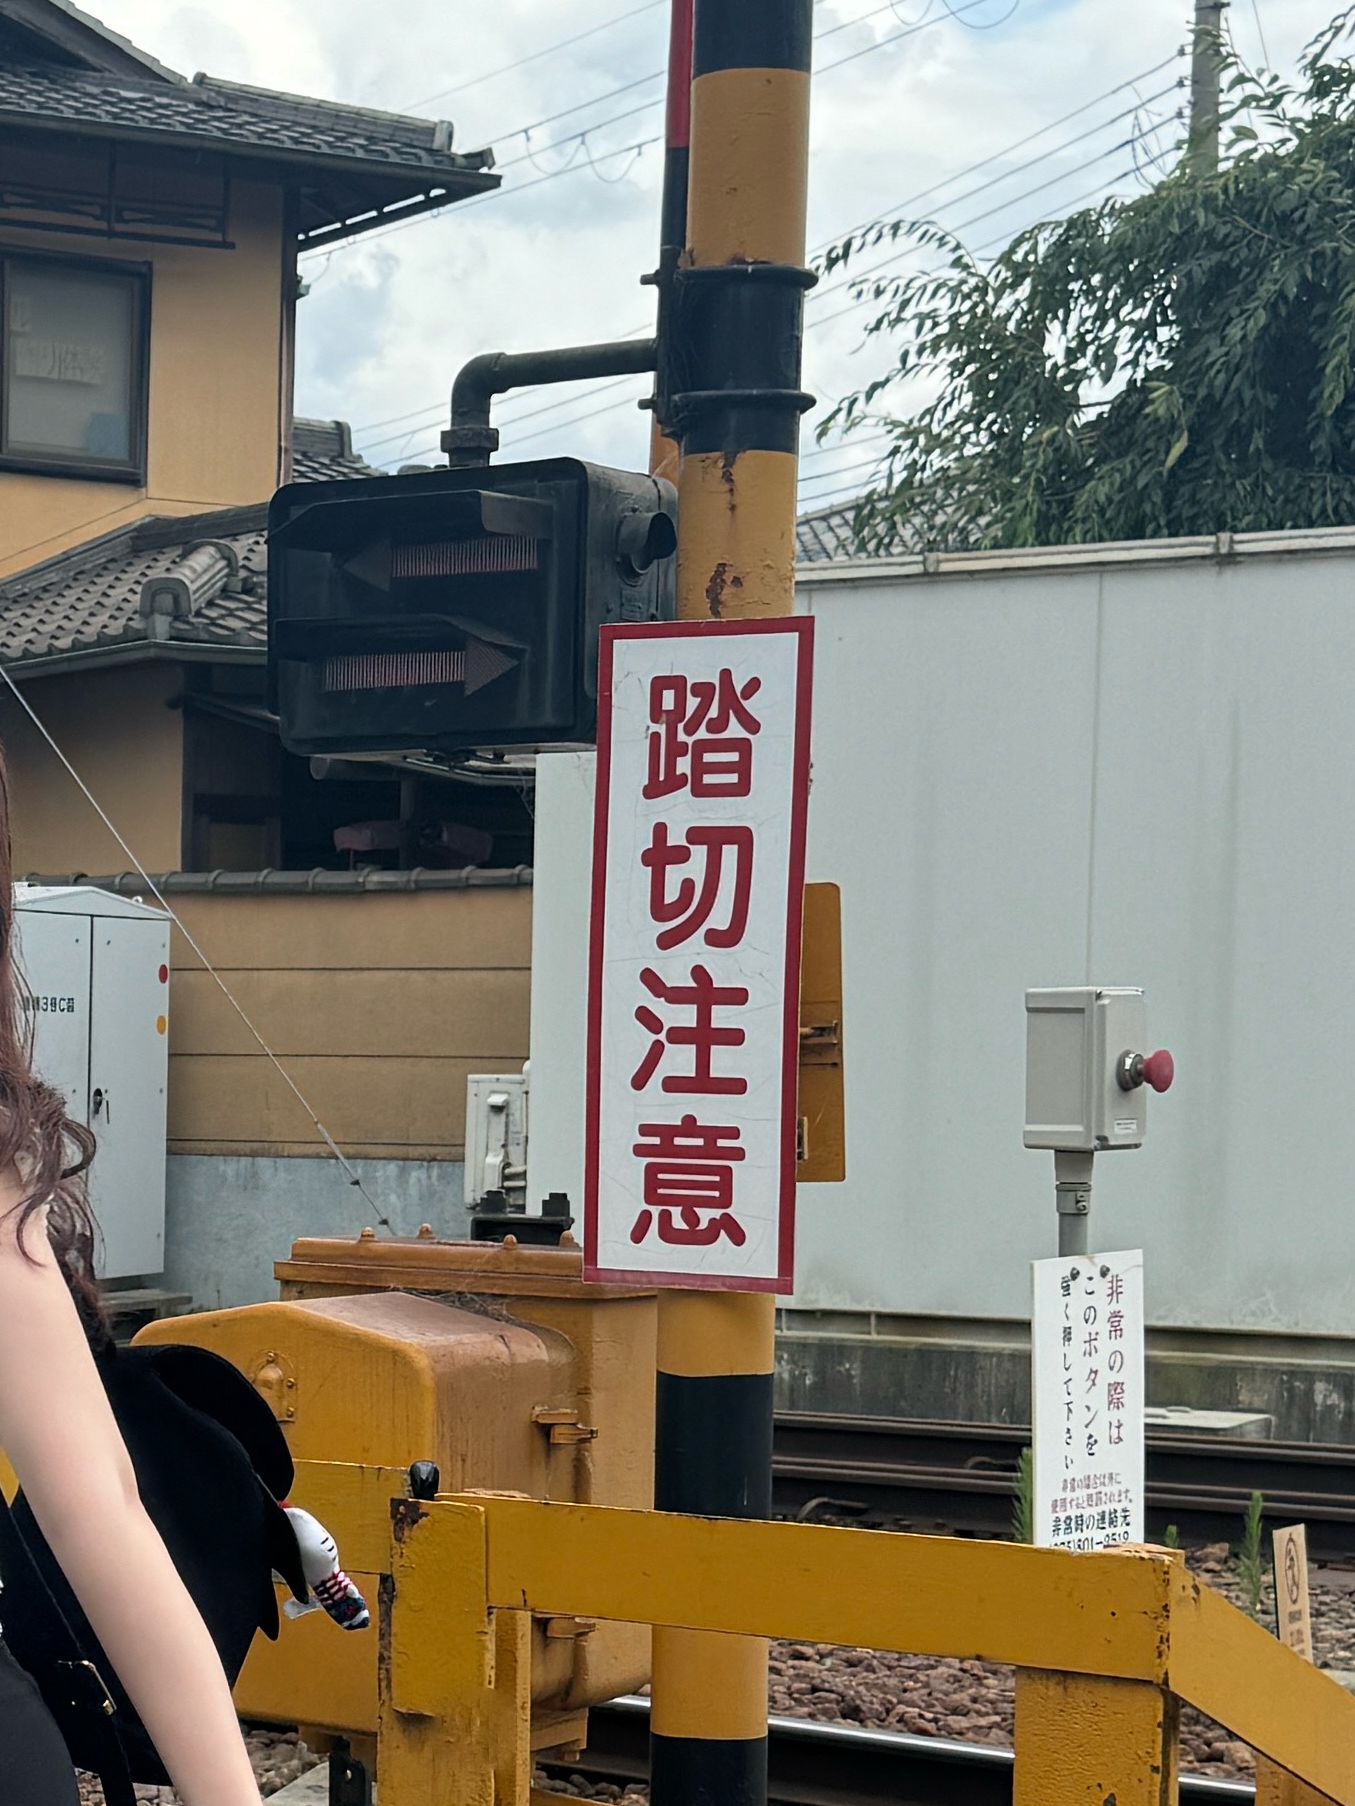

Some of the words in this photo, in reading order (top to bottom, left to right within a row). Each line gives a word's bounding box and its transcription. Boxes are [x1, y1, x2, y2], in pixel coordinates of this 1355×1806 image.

[630, 667, 762, 1248] 踏切注意
[1082, 1275, 1100, 1457] このボタンを
[1106, 1273, 1126, 1445] 非常の際は
